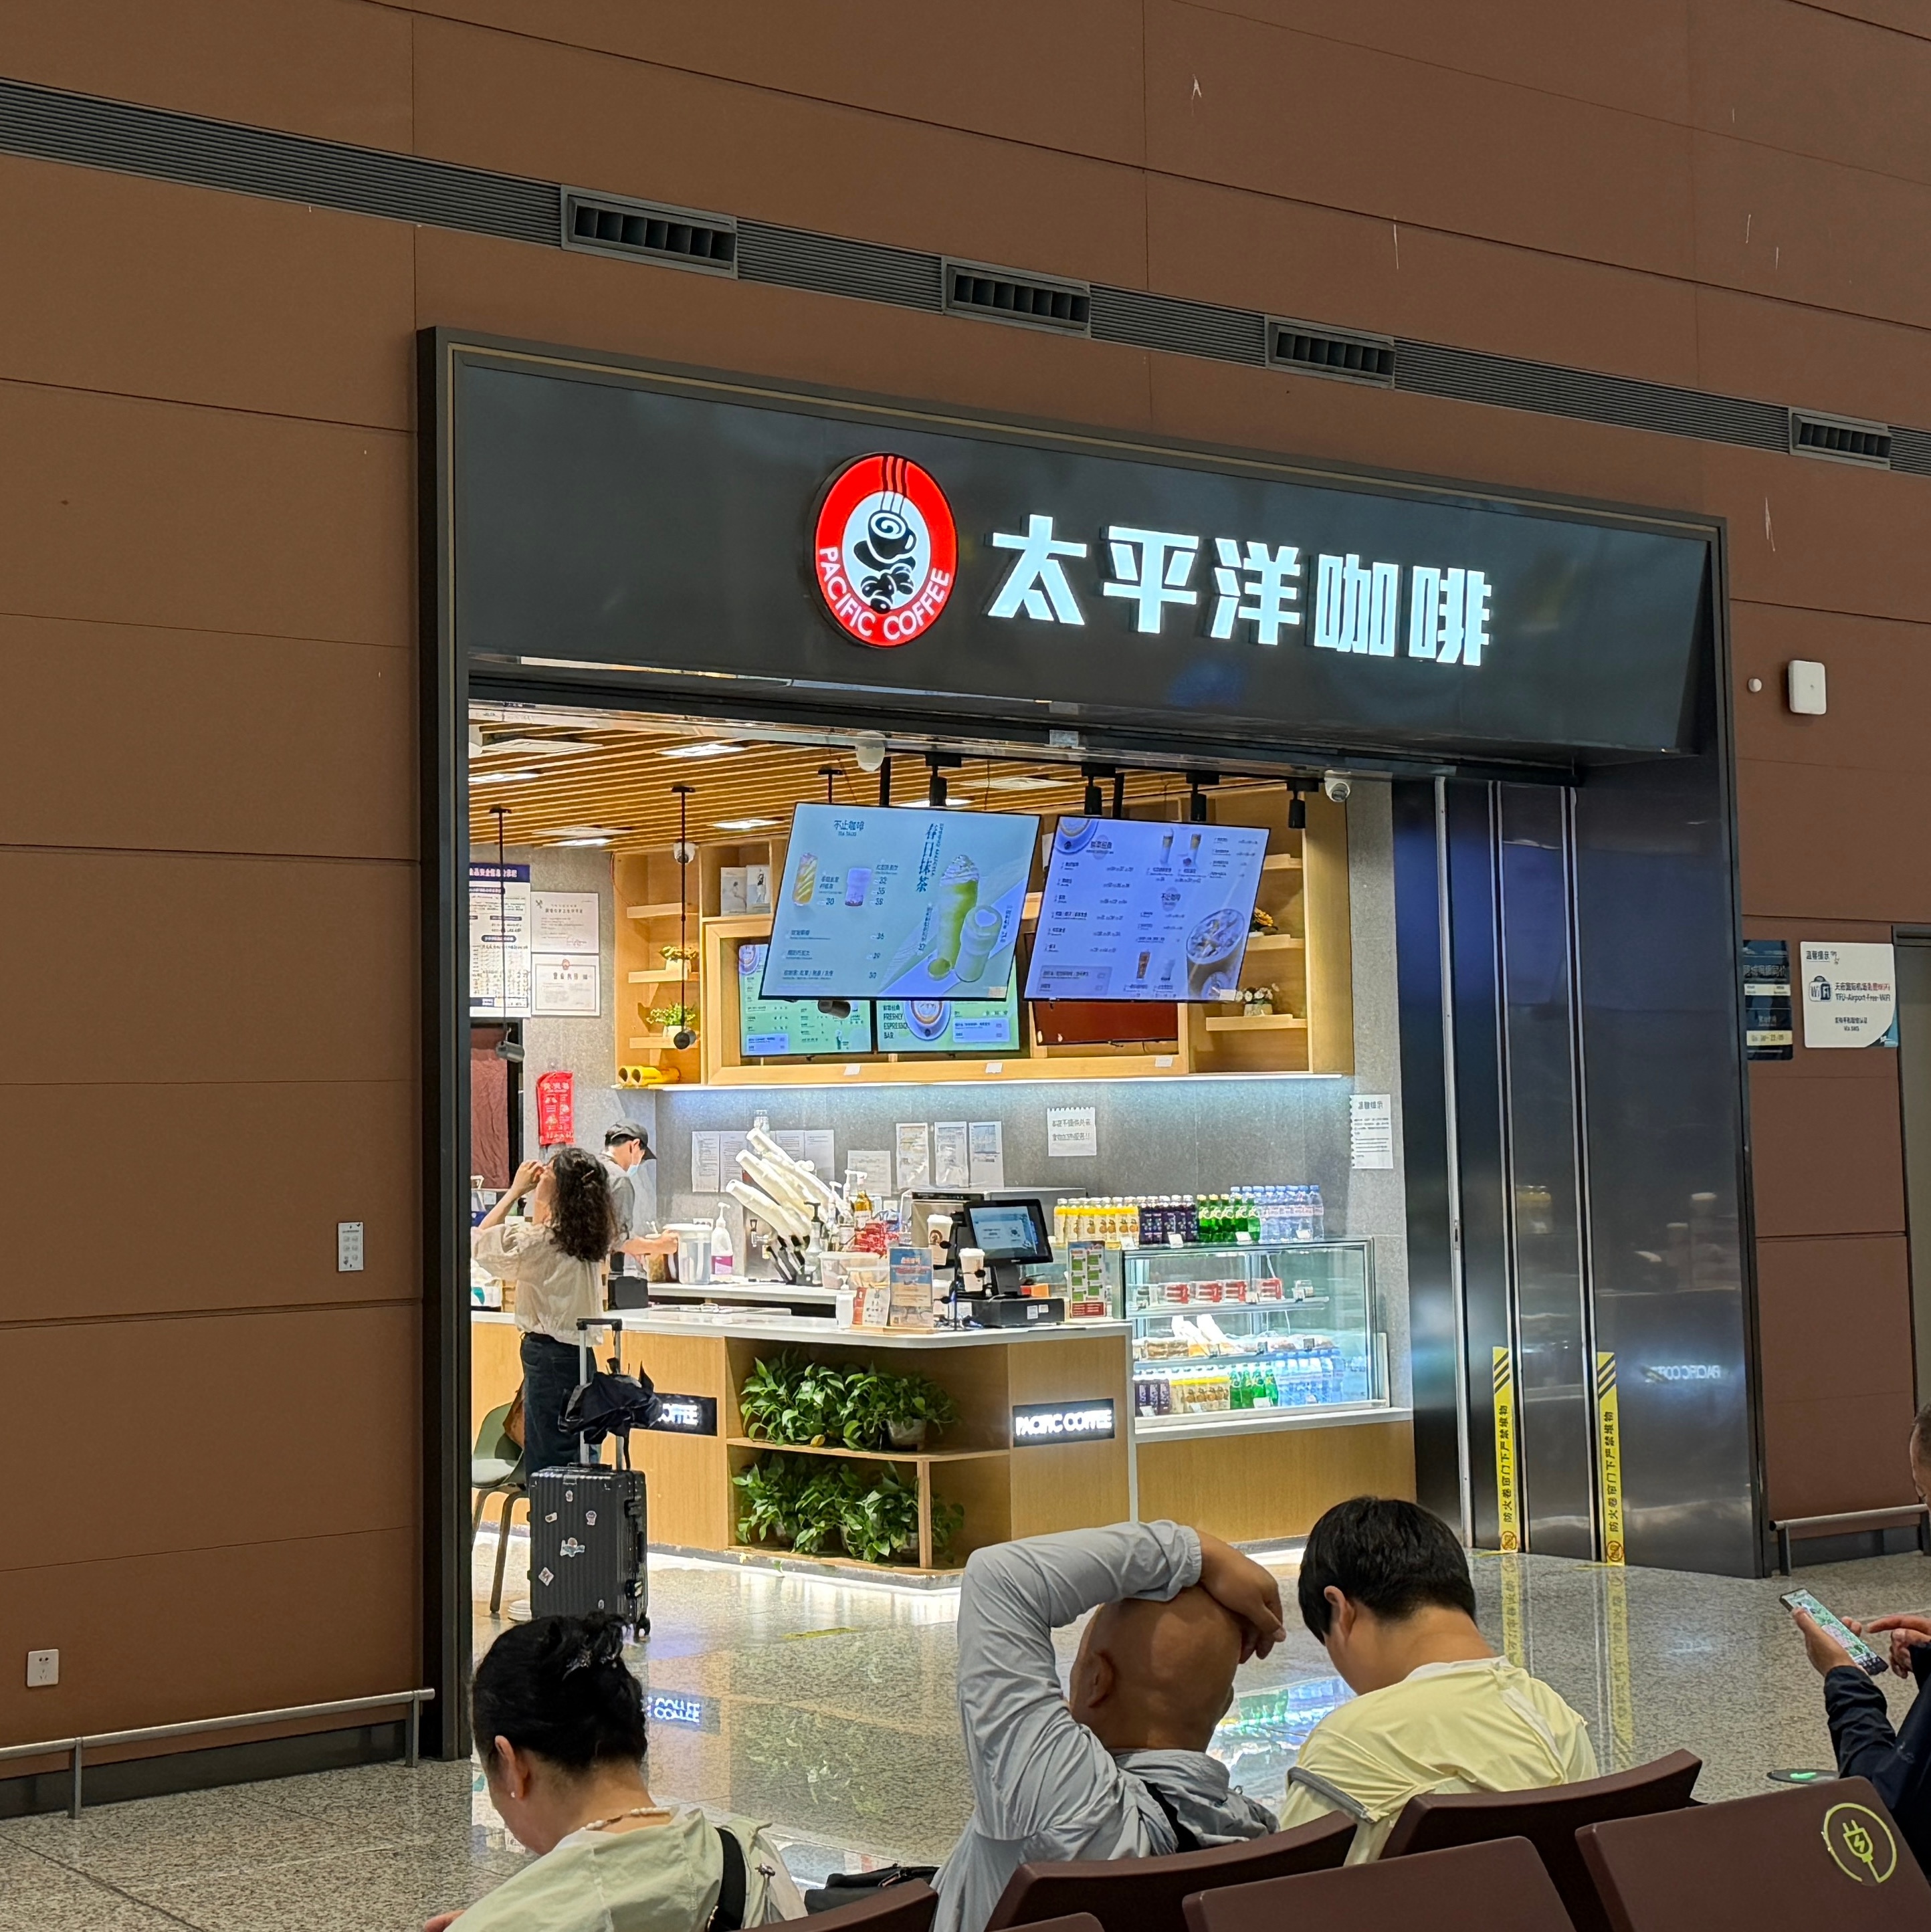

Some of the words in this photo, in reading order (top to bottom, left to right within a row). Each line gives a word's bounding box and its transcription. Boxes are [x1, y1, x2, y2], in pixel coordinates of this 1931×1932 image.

[819, 546, 876, 637] PACIFIC
[883, 568, 950, 640] COFFEE
[987, 514, 1492, 667] 太平洋咖啡
[1015, 1414, 1063, 1436] PACIFIC
[1063, 1409, 1112, 1432] COFFEE
[1499, 1405, 1513, 1523] 防火卷帘门下严禁堆物
[1604, 1412, 1619, 1532] 防火卷帘门下严禁堆物
